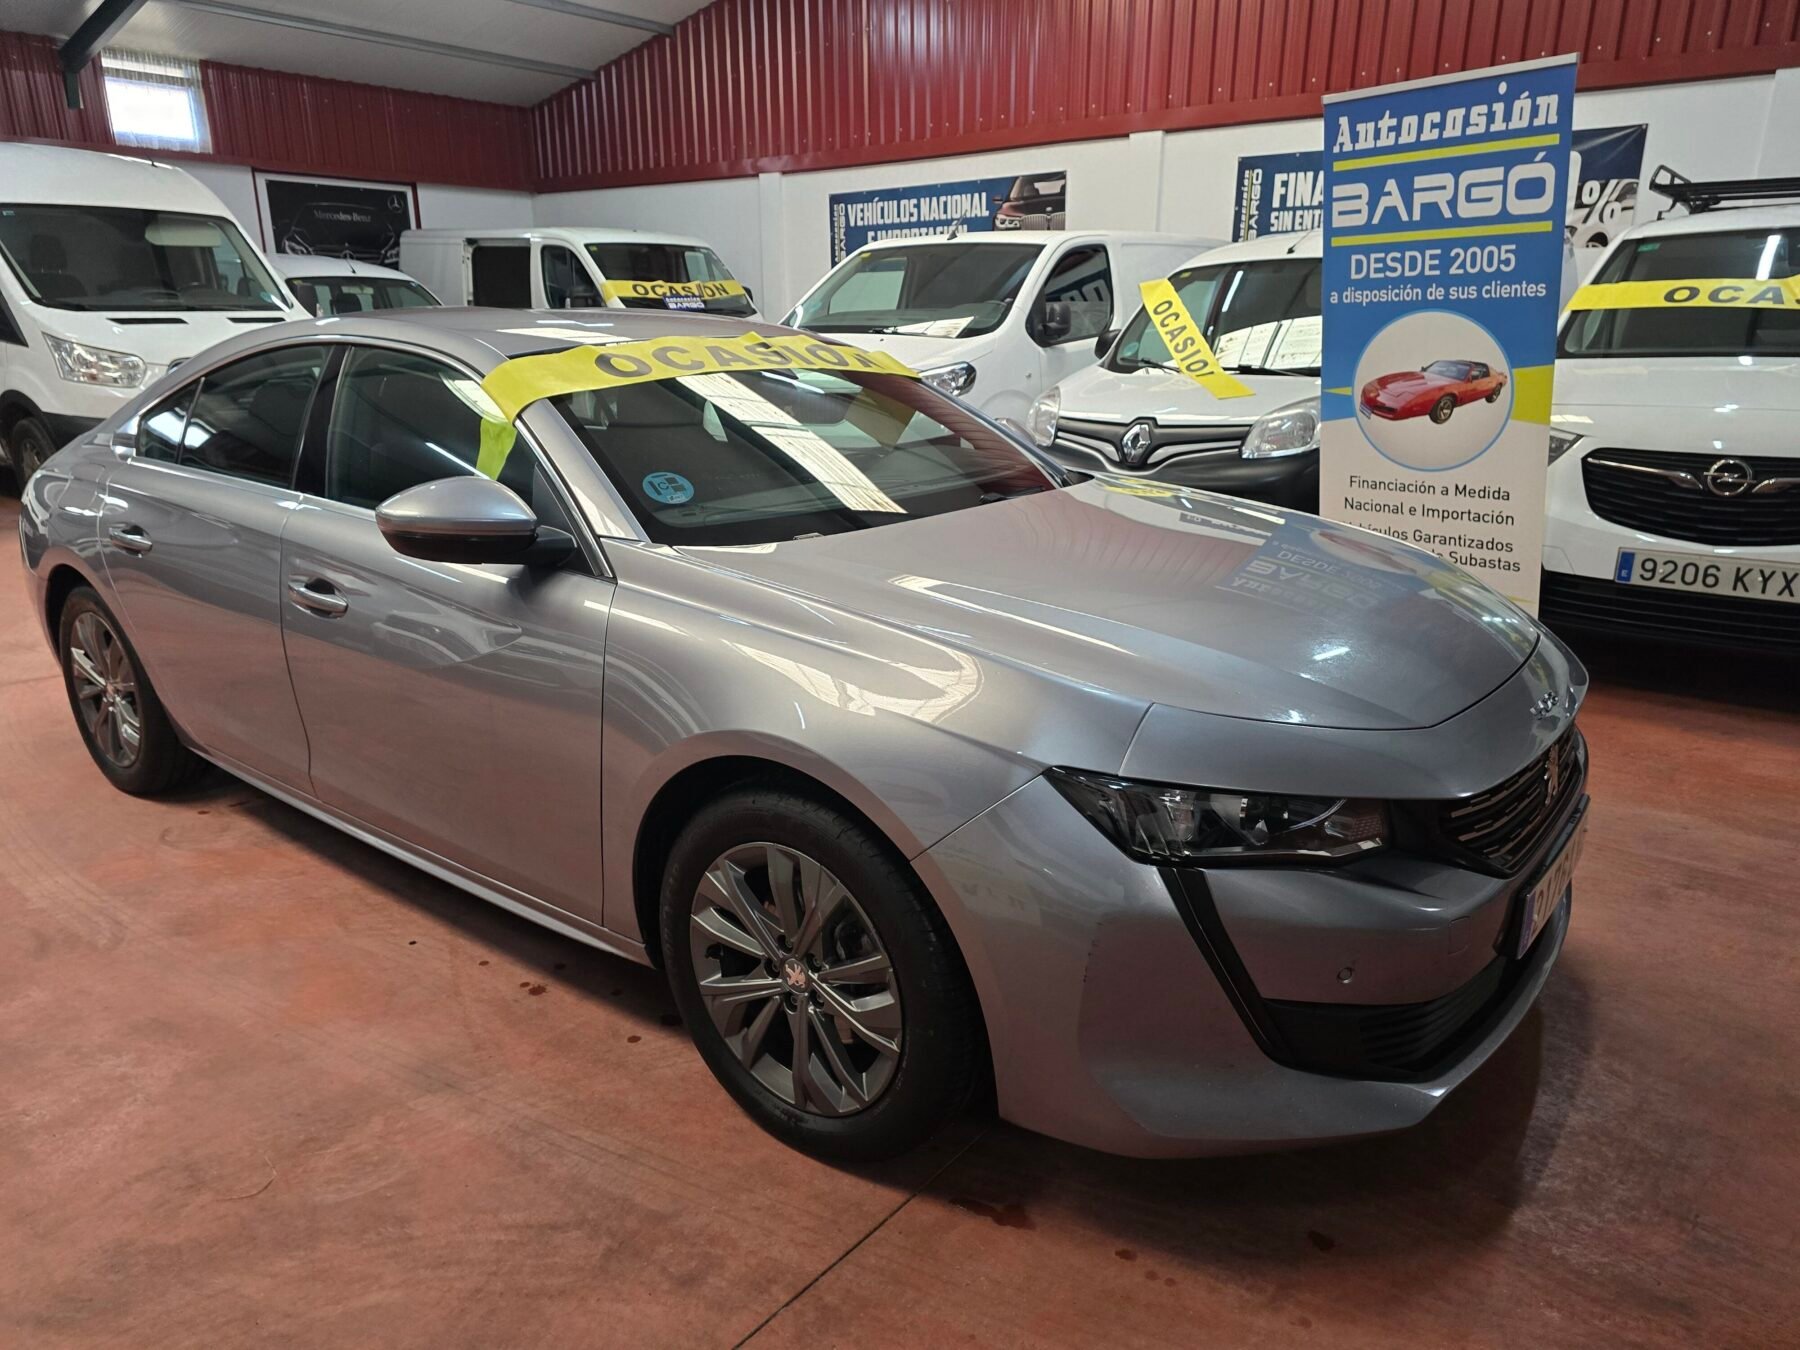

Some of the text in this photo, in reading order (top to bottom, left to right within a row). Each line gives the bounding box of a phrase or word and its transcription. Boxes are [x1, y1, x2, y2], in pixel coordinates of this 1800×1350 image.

[1332, 81, 1559, 153] Autocasión
[1331, 151, 1556, 228] BARGÓ
[847, 191, 989, 227] VEHÍCULOS NACIONAL
[1270, 210, 1293, 232] SIN
[1351, 244, 1517, 280] DESDE 2005
[1330, 279, 1547, 307] a disposición de sus clientes
[1663, 285, 1800, 305] OCA
[1349, 475, 1511, 502] Financiación a Medida
[1344, 496, 1515, 526] Nacional e Importación
[1412, 529, 1514, 553] Garantizados
[1449, 550, 1521, 573] Subastas
[1639, 557, 1800, 598] 9206 KYX
